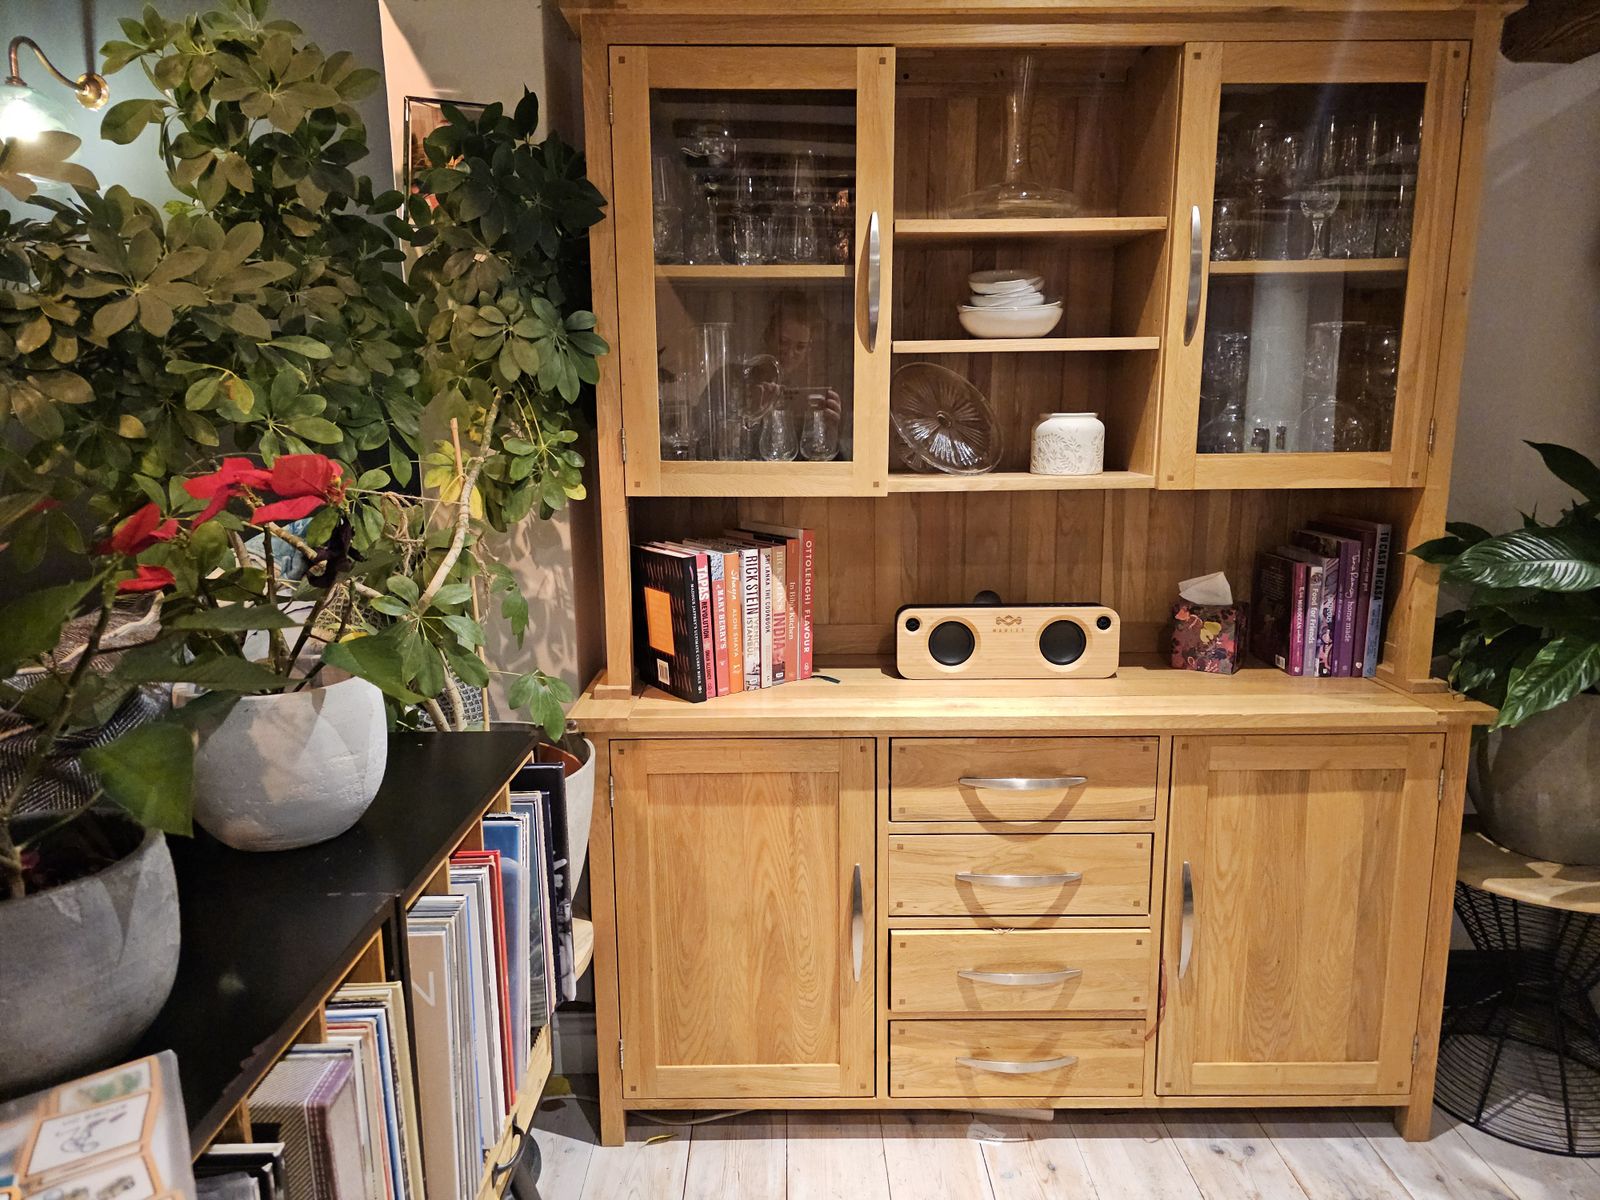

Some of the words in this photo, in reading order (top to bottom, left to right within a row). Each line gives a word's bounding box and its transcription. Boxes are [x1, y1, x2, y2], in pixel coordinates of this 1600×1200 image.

[1380, 532, 1389, 542] TU
[1377, 544, 1388, 565] CASA
[746, 556, 759, 582] RICK
[1376, 568, 1385, 577] MI
[697, 566, 709, 600] TAPAS
[726, 569, 739, 600] Shaya
[1374, 580, 1383, 601] CASA
[717, 590, 725, 612] MARY
[746, 585, 759, 615] STEIN
[1346, 601, 1354, 621] home
[719, 614, 727, 649] BERRY'S
[774, 612, 786, 651] INDIA
[1308, 619, 1316, 644] Friends
